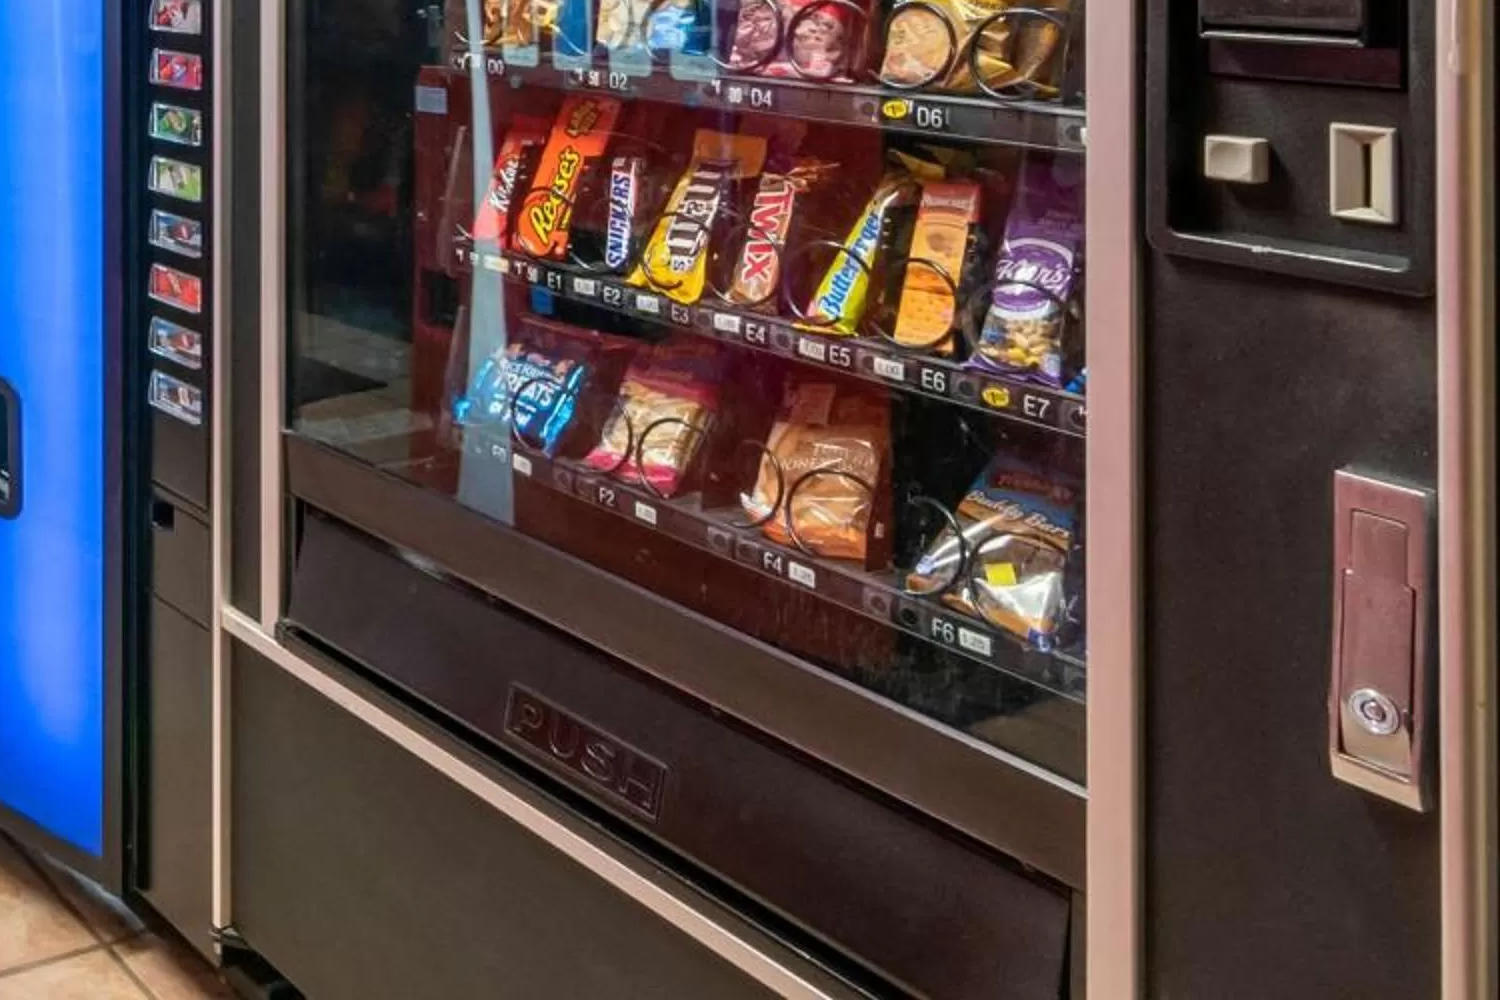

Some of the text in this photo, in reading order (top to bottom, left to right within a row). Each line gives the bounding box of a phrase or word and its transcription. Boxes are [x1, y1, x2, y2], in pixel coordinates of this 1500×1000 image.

[751, 88, 773, 108] D4
[916, 106, 943, 129] D6
[741, 180, 795, 282] TWIX
[547, 270, 562, 289] E1
[603, 285, 621, 304] E2
[671, 305, 690, 324] E3
[745, 322, 767, 343] E4
[829, 344, 851, 368] E5
[921, 367, 946, 392] E6
[1023, 394, 1051, 418] E7
[599, 487, 616, 507] F2
[762, 550, 784, 575] F4
[930, 615, 956, 644] F6
[510, 703, 654, 809] PUSH
